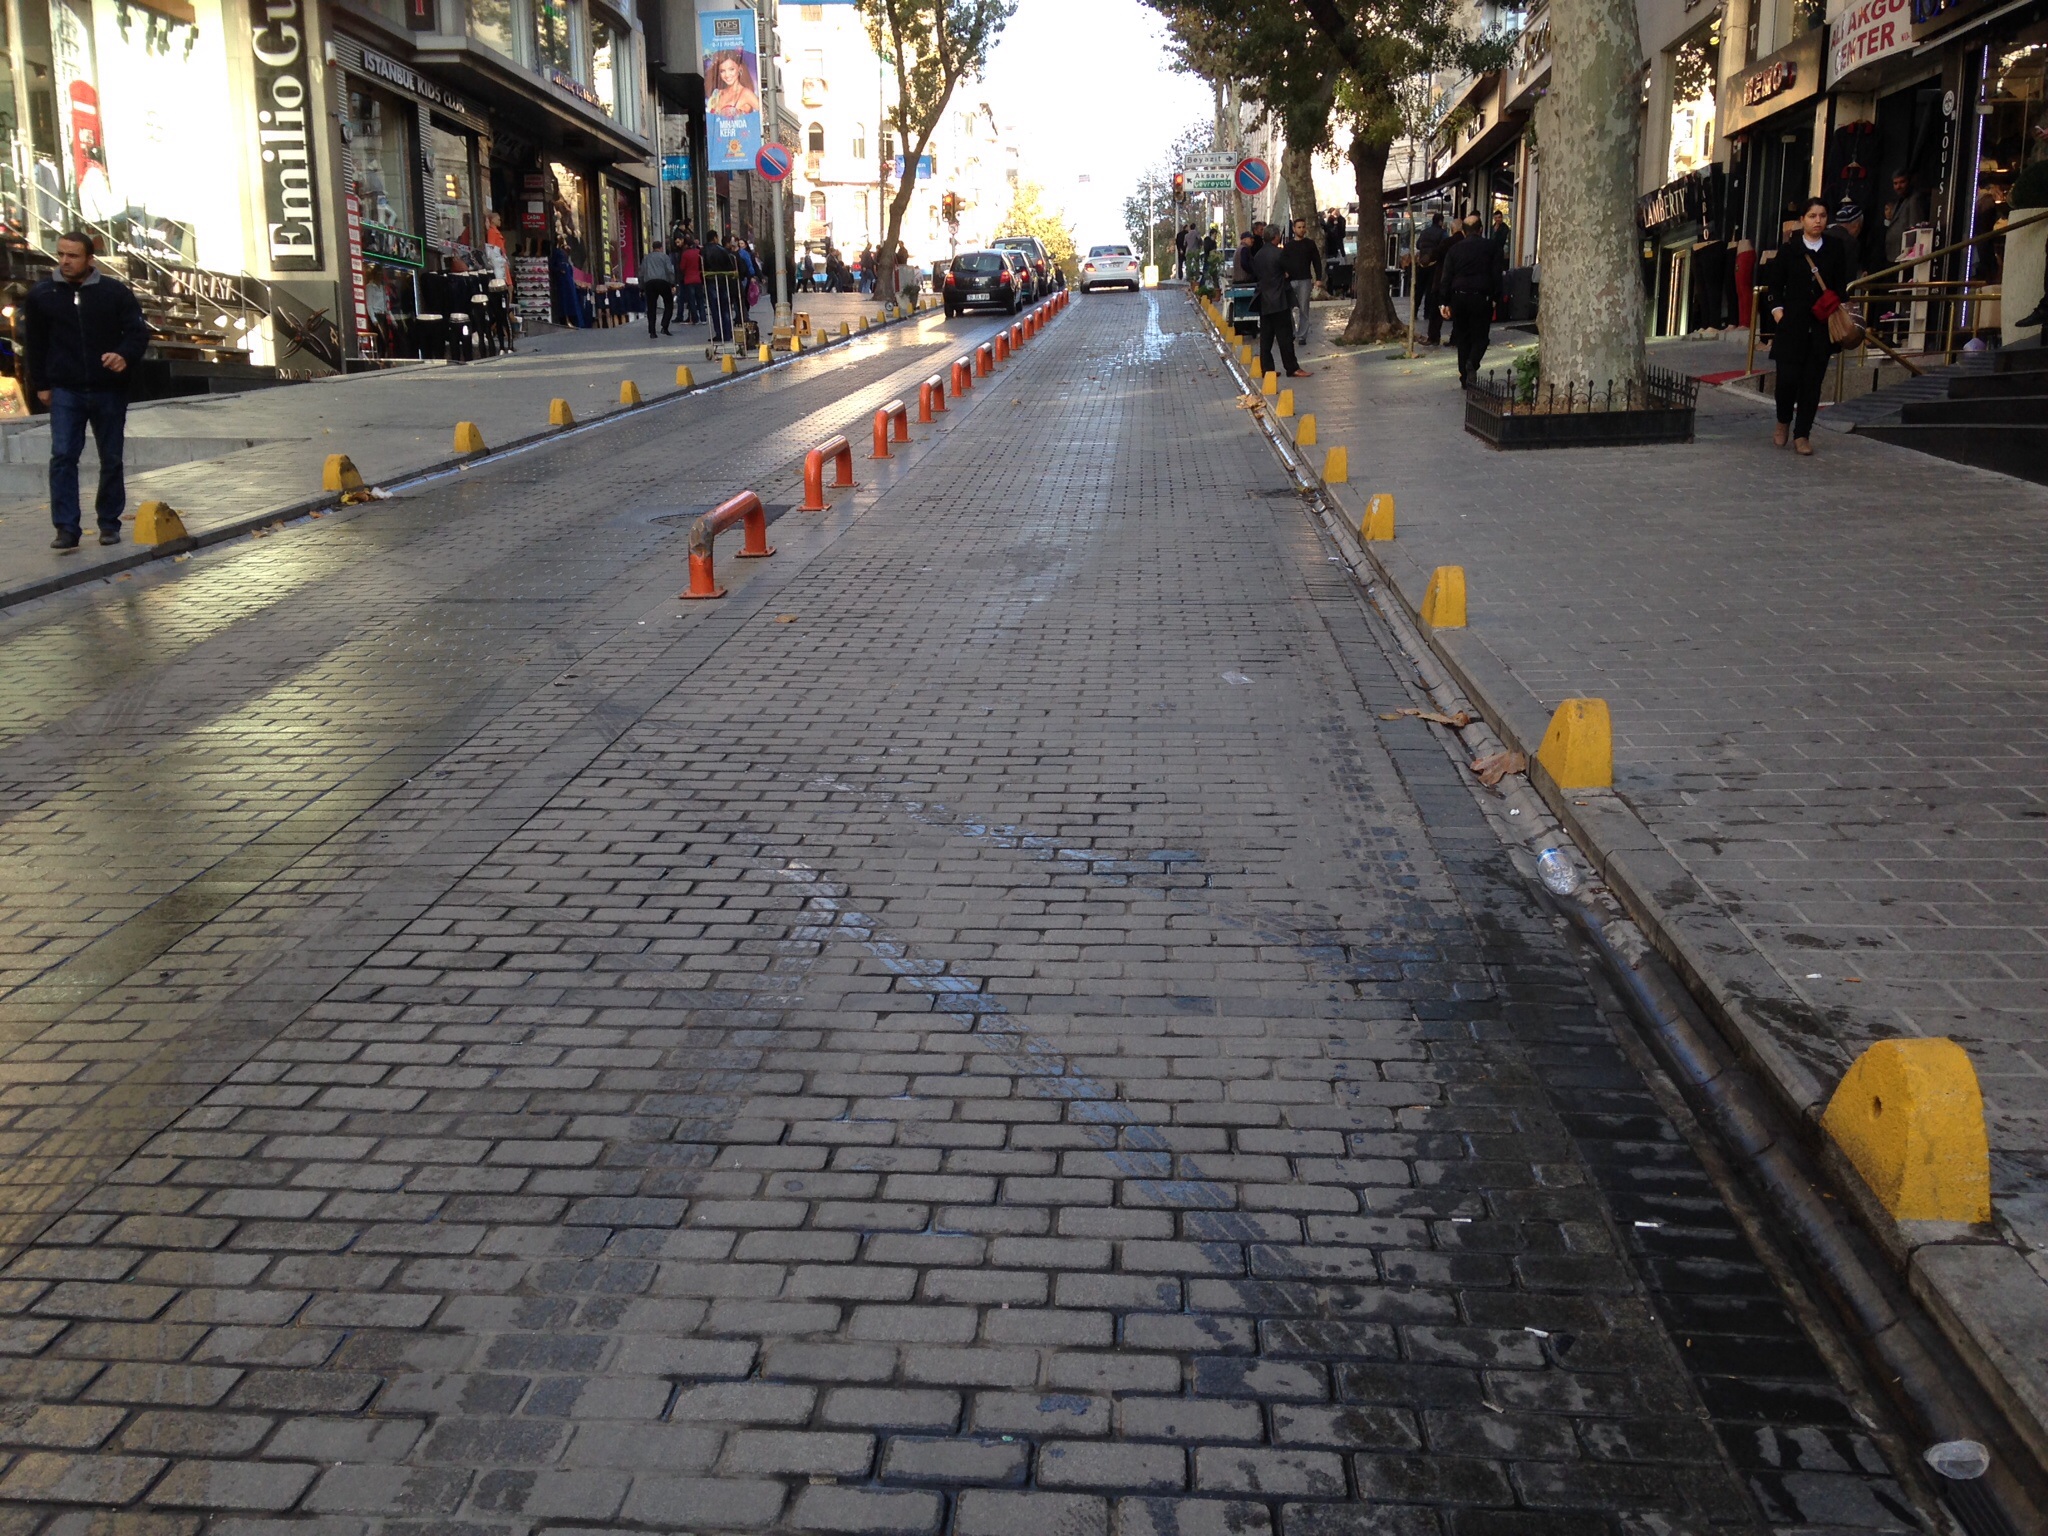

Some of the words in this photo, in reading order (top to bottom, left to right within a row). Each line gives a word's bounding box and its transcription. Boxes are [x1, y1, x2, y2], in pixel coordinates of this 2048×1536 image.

[1834, 22, 1895, 76] CENTER
[417, 75, 441, 103] KIDS
[443, 91, 465, 114] CLUB
[720, 119, 747, 129] MIRANDA
[720, 128, 736, 137] KERR
[259, 75, 316, 262] Emilio
[1939, 121, 1949, 195] LOUIS
[1643, 187, 1686, 228] LAMBERTY
